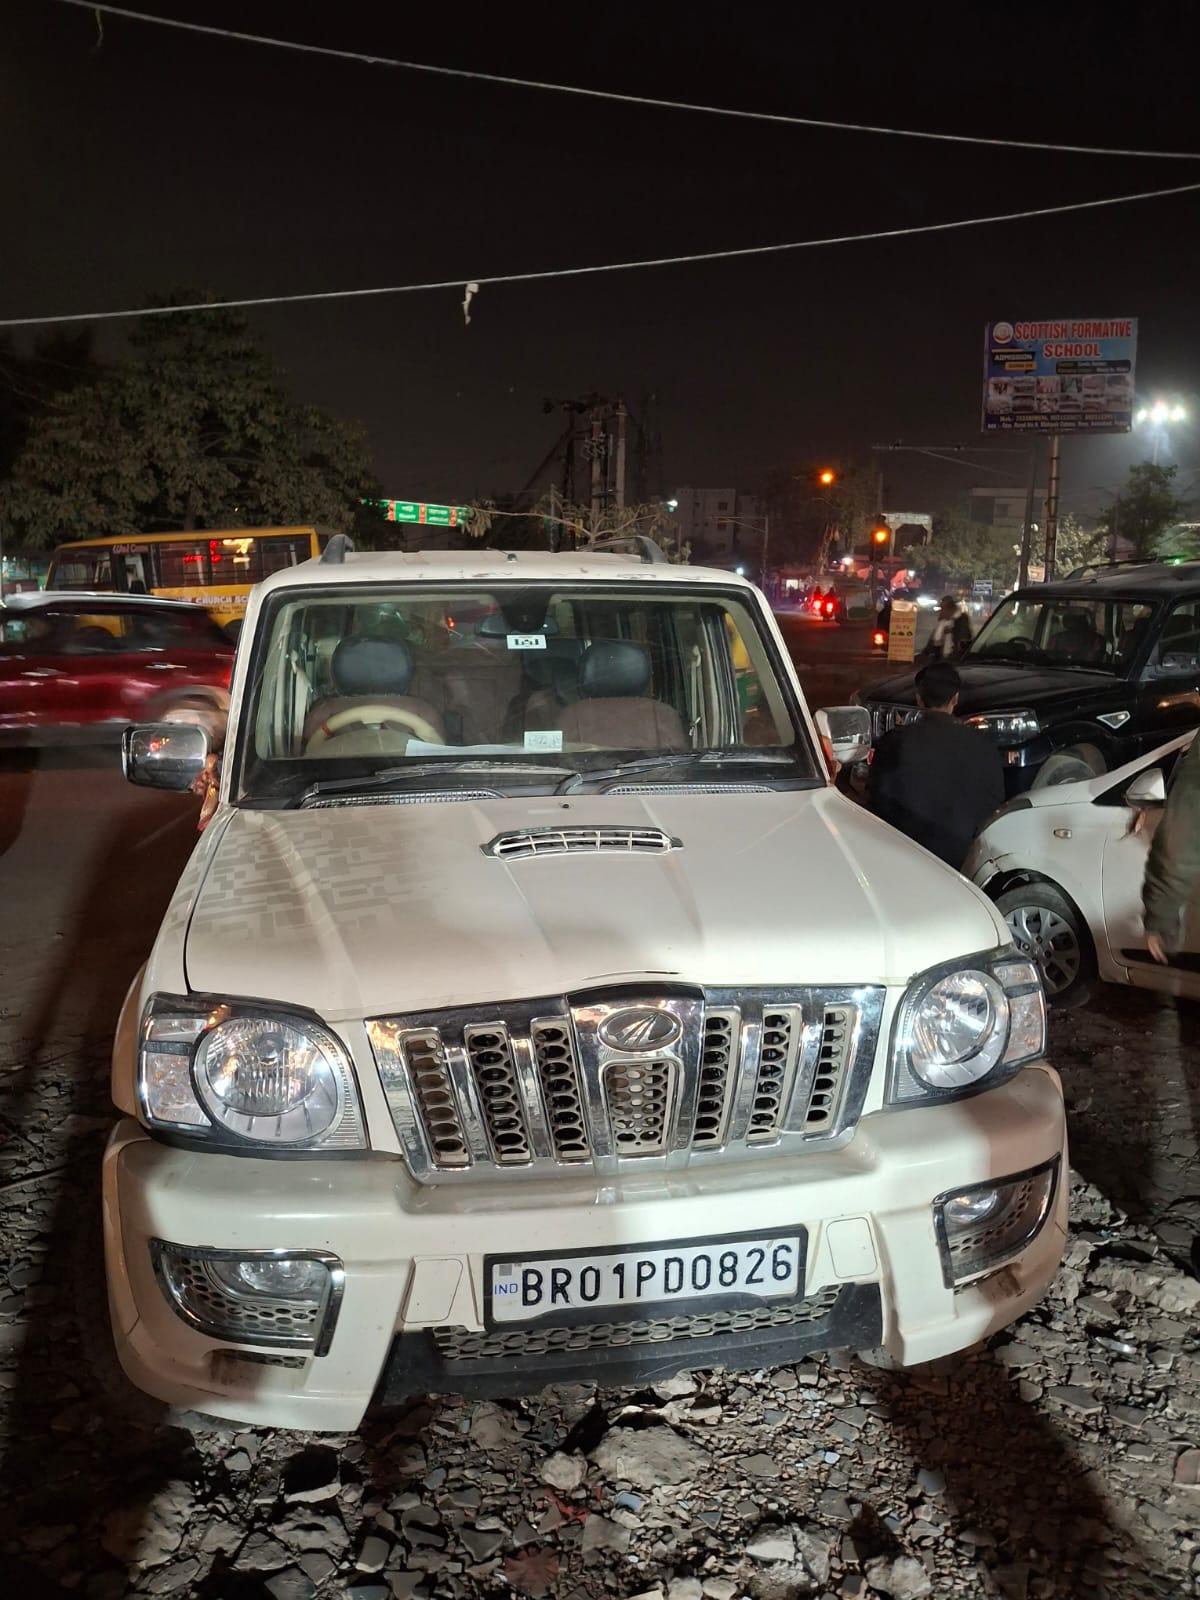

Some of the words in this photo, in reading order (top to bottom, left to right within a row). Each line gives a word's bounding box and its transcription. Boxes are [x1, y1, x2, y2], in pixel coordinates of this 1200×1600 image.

[1015, 322, 1068, 340] SCOTTISH
[1071, 321, 1132, 338] FORMATIVE
[1044, 343, 1100, 357] SCHOOL
[522, 1245, 792, 1306] BR01PD0826
[494, 1283, 518, 1295] IND
